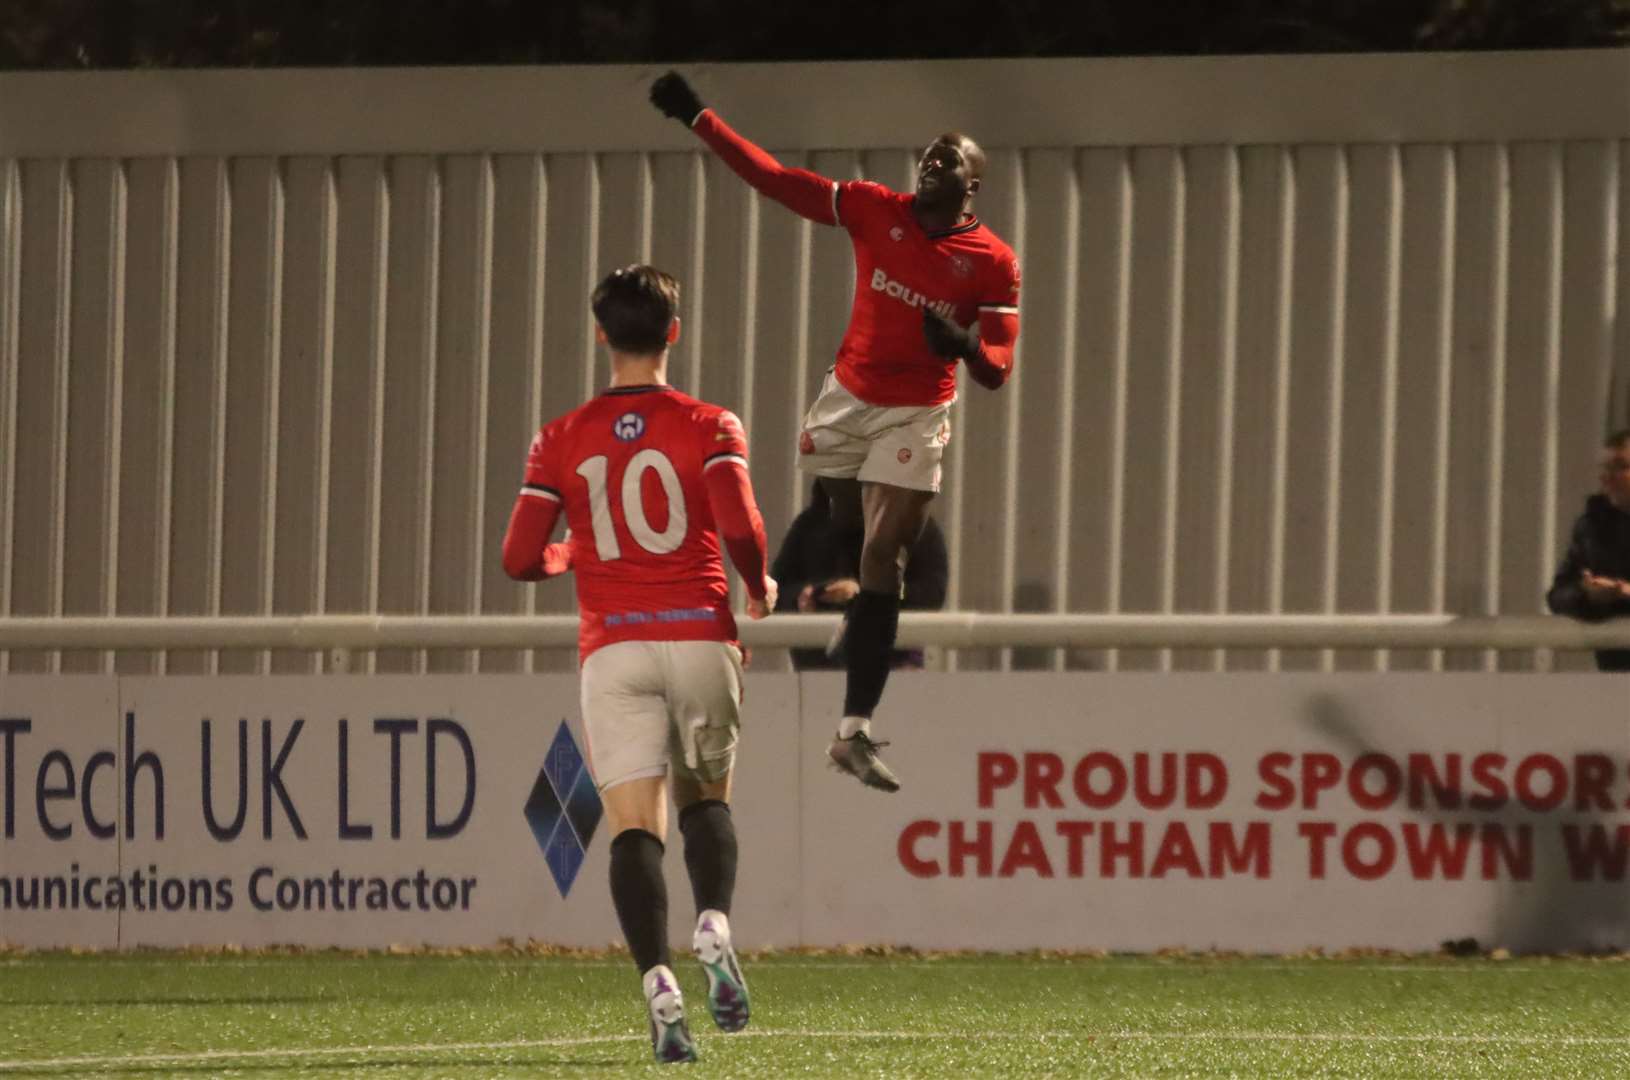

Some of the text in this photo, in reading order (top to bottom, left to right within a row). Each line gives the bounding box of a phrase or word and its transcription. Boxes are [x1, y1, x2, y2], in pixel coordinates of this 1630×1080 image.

[576, 448, 688, 562] 10
[0, 712, 477, 842] Tech UK LTD
[976, 751, 1630, 812] PROUD SPONSOR
[897, 819, 1271, 879] CHATHAM
[1299, 822, 1532, 881] TOWN
[248, 866, 477, 911] Contractor
